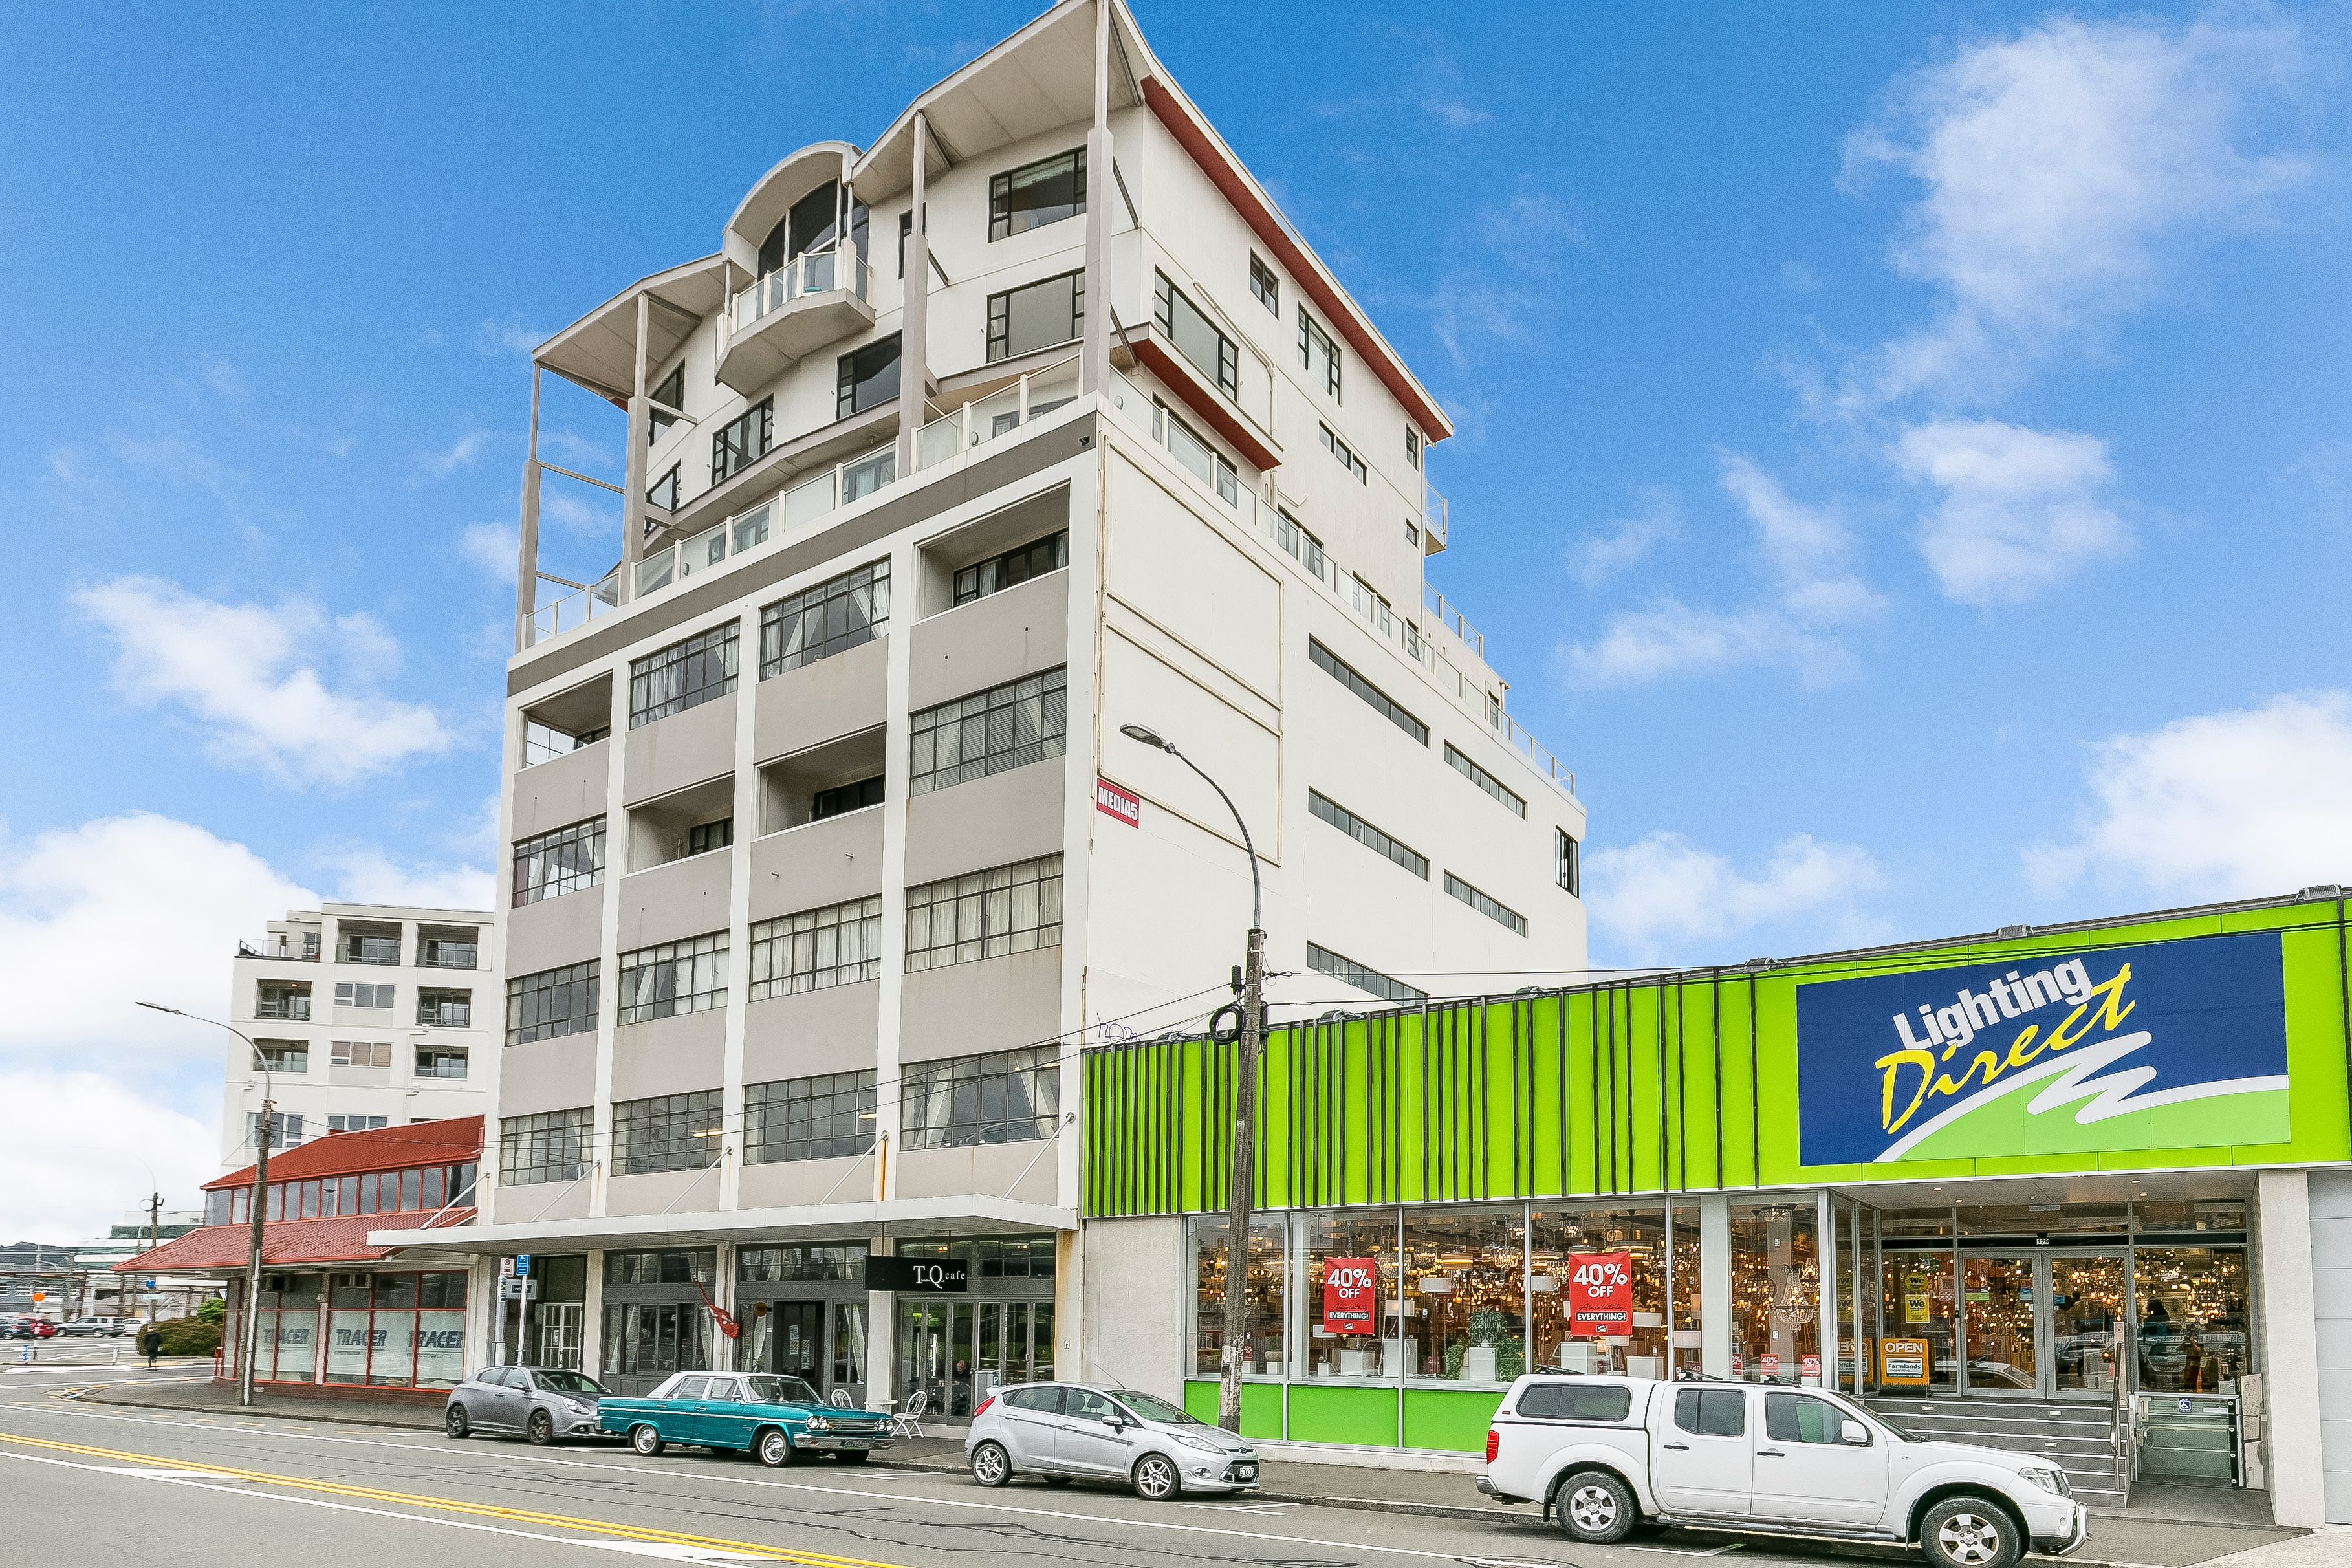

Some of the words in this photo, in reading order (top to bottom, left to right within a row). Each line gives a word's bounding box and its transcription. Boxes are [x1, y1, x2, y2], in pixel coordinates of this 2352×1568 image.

[1098, 785, 1138, 821] MEDIA5
[1892, 958, 2093, 1051] Lighting
[1875, 963, 2135, 1135] Direct
[945, 1270, 966, 1280] cafe
[1327, 1267, 1373, 1289] 40%
[1573, 1263, 1628, 1286] 40%
[1338, 1287, 1360, 1299] OFF
[1587, 1285, 1613, 1298] OFF
[1578, 1303, 1625, 1312] Absolutely
[1908, 1300, 1926, 1308] We
[1884, 1342, 1923, 1353] OPEN
